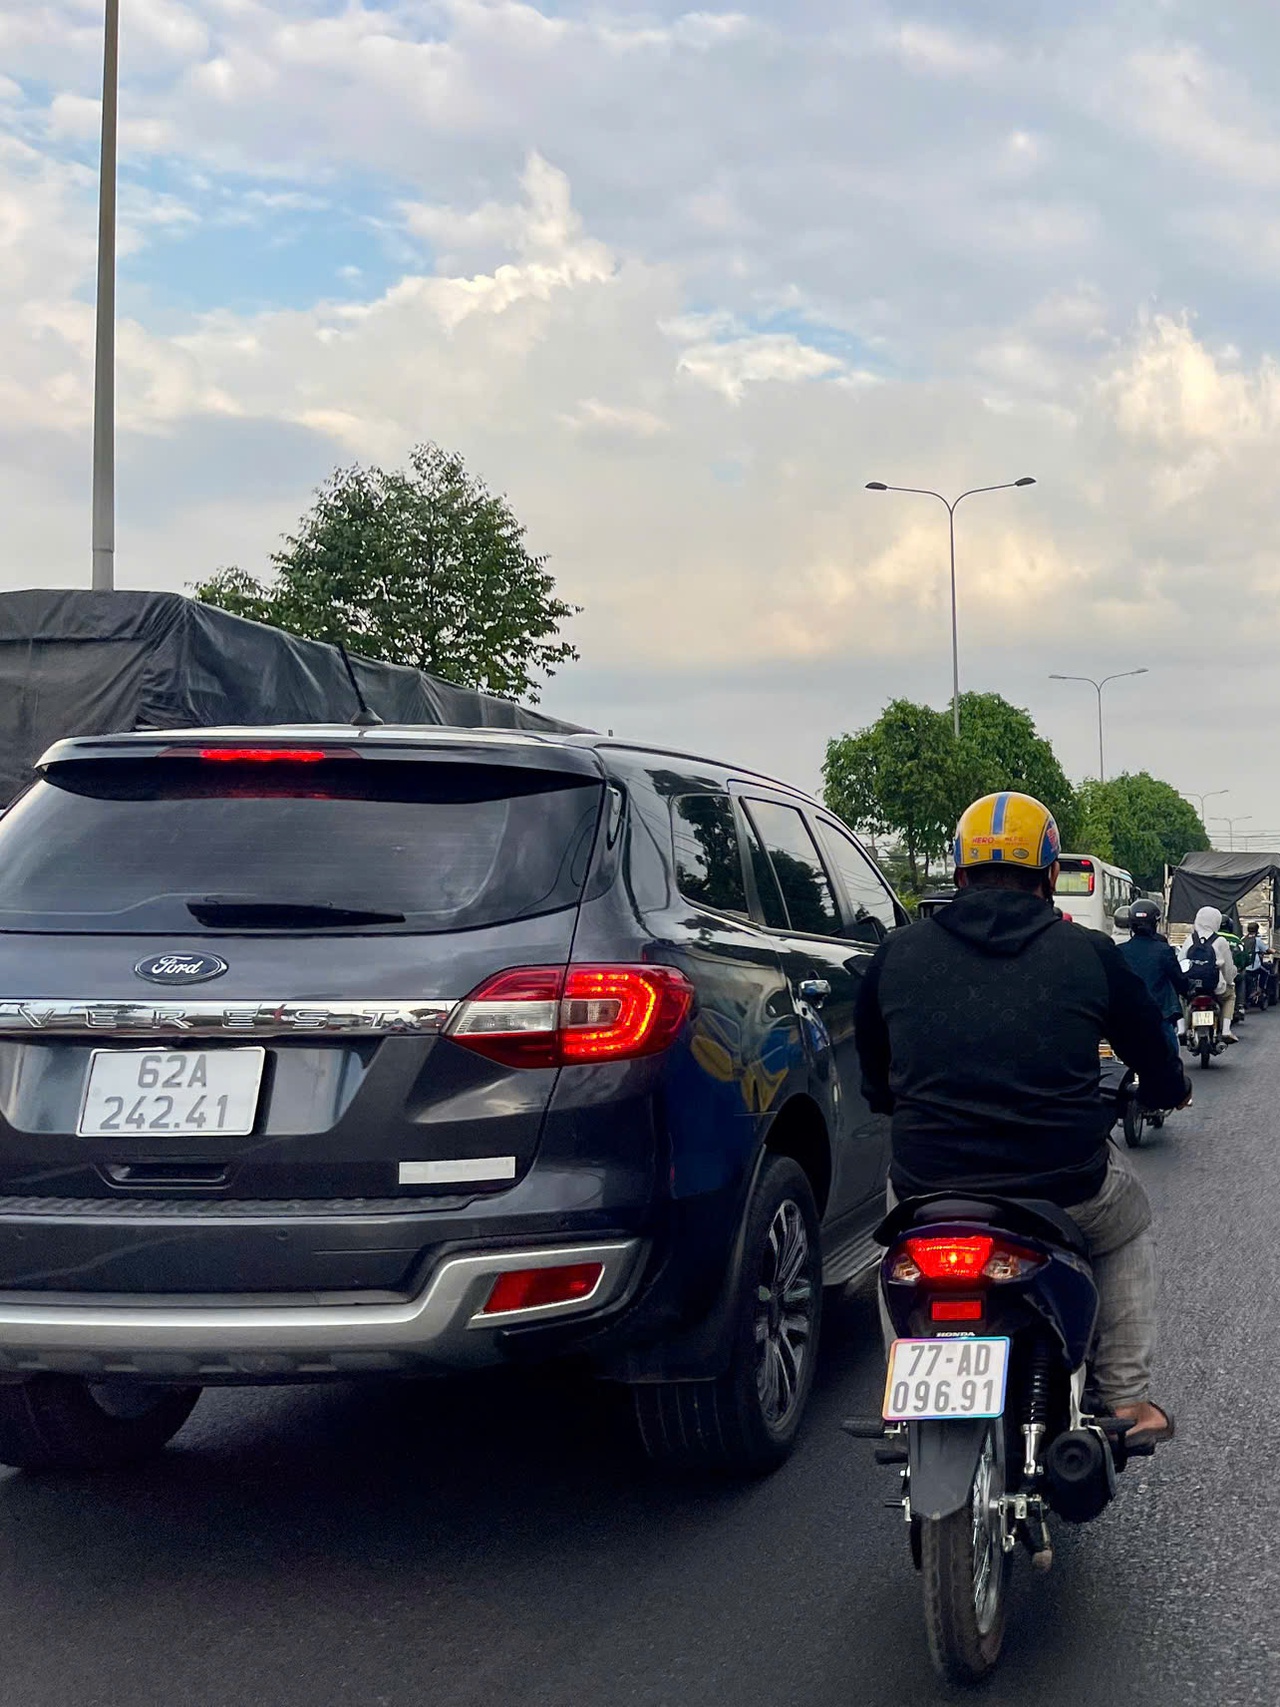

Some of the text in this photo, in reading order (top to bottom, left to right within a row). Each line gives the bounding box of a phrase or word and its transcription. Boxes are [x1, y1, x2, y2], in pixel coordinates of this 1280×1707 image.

[151, 955, 201, 975] Ford
[137, 1053, 208, 1088] 62A
[99, 1094, 229, 1131] 242.41
[908, 1344, 991, 1376] 77-AD
[892, 1380, 994, 1413] 096.91
